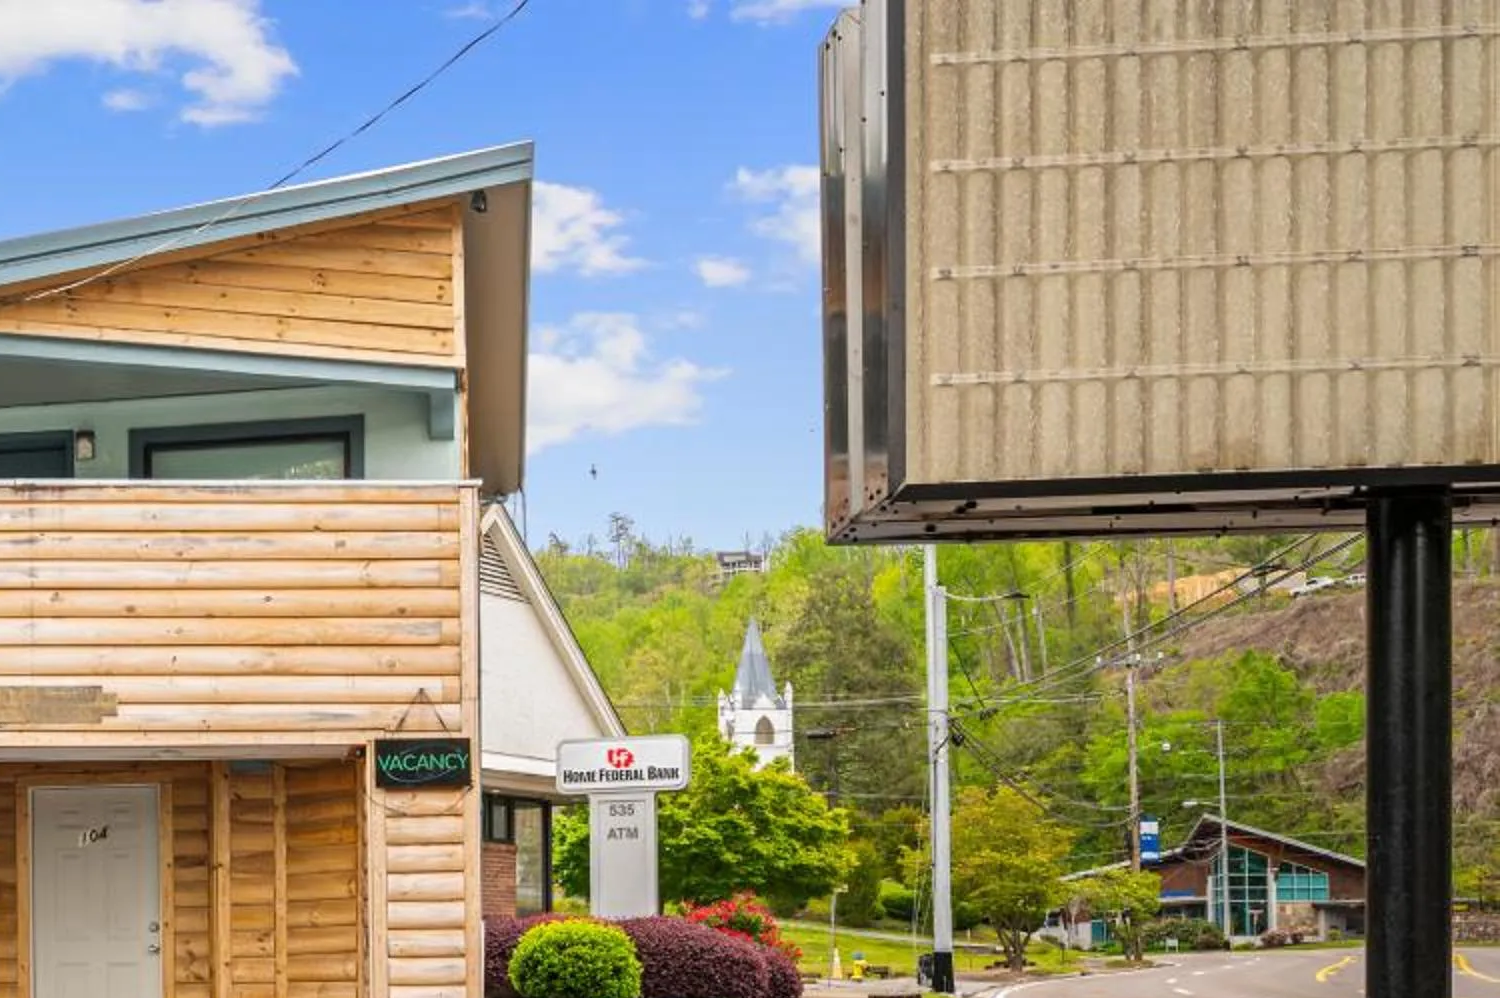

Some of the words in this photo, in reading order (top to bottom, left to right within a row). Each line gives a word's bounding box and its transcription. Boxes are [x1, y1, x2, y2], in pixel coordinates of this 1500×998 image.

[377, 752, 469, 772] VACANCY
[563, 769, 596, 784] HOME
[599, 767, 645, 783] FEDERAL
[647, 766, 680, 781] BANK
[609, 803, 635, 817] 535
[81, 824, 109, 846] 104
[607, 827, 639, 840] ATM
